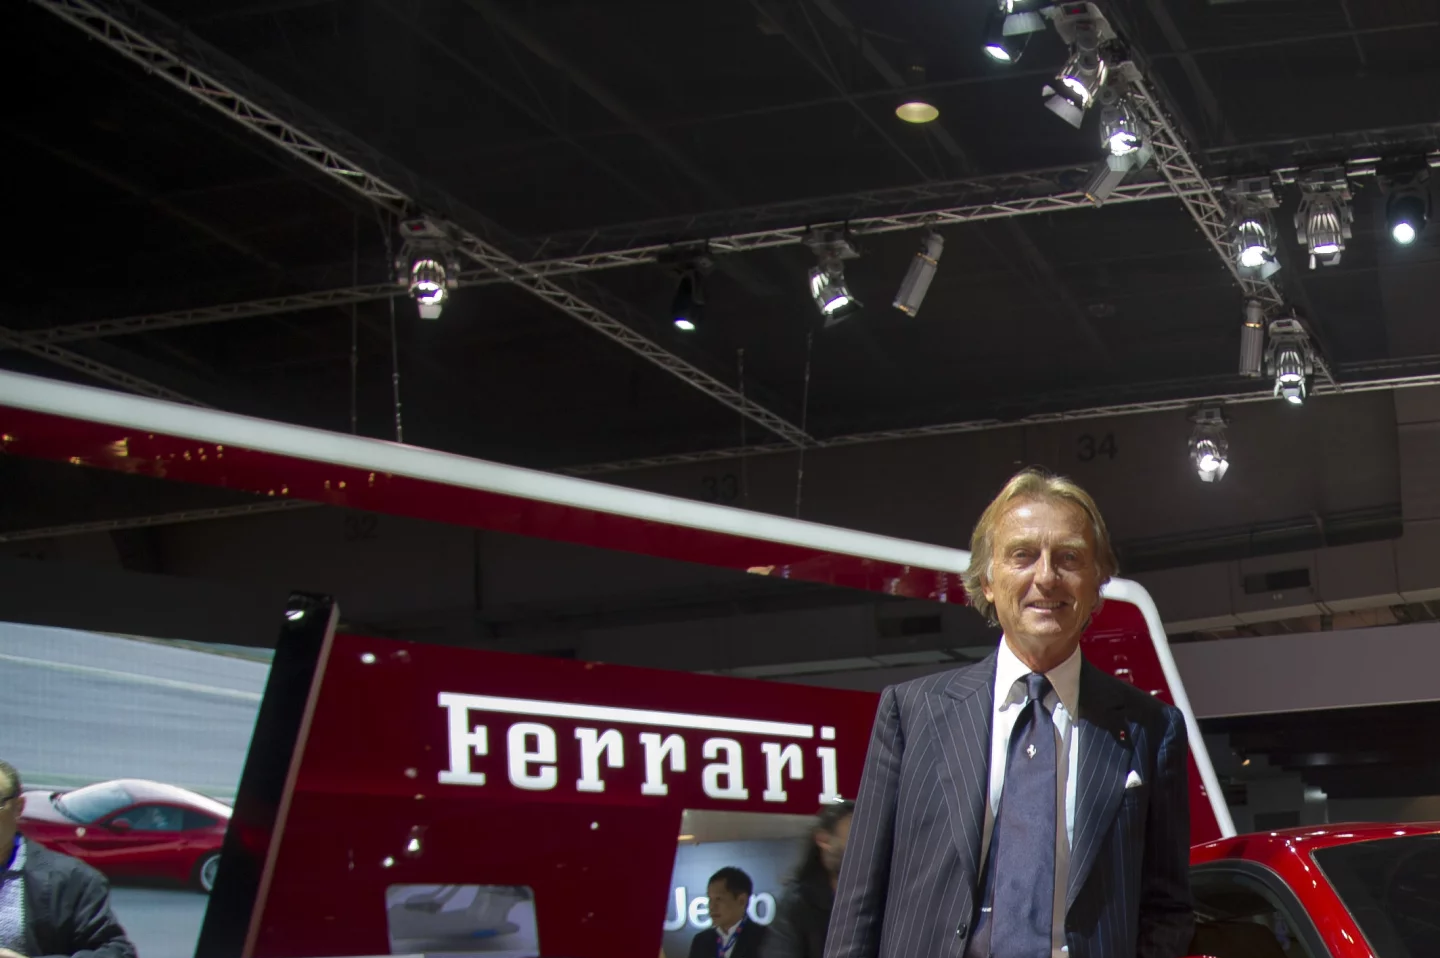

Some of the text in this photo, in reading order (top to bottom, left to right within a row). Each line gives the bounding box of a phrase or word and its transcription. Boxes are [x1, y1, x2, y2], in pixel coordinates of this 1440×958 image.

[1077, 433, 1118, 461] 34
[437, 691, 841, 804] Ferrari
[662, 886, 776, 931] Jep
